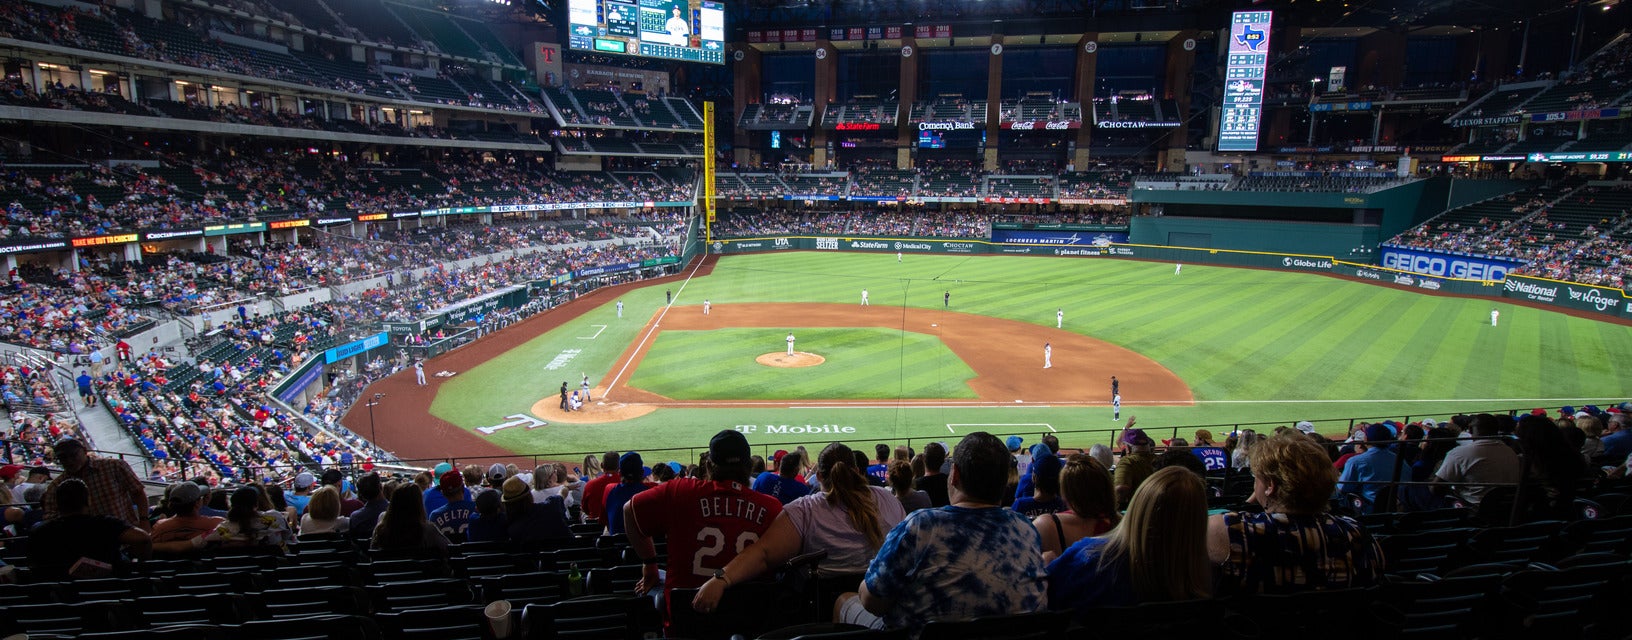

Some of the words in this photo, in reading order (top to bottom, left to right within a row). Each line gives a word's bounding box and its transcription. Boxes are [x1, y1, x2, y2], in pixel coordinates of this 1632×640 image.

[542, 46, 555, 63] T
[1484, 115, 1519, 124] STAFFING
[1545, 112, 1565, 121] 105.3
[955, 121, 975, 130] Bank
[1103, 121, 1145, 129] CHOCTAW
[775, 238, 789, 246] UTA
[816, 241, 839, 250] SELTZER
[1293, 259, 1316, 268] Globe
[1317, 261, 1332, 269] Life
[1384, 252, 1447, 276] GEICO
[580, 266, 604, 277] Germania
[1515, 281, 1558, 297] National
[1583, 288, 1619, 311] Kroger
[426, 318, 439, 327] TOYOTA
[735, 424, 757, 434] T
[765, 424, 857, 434] Mobile
[1204, 456, 1225, 471] 25
[700, 496, 767, 526] BELTRE
